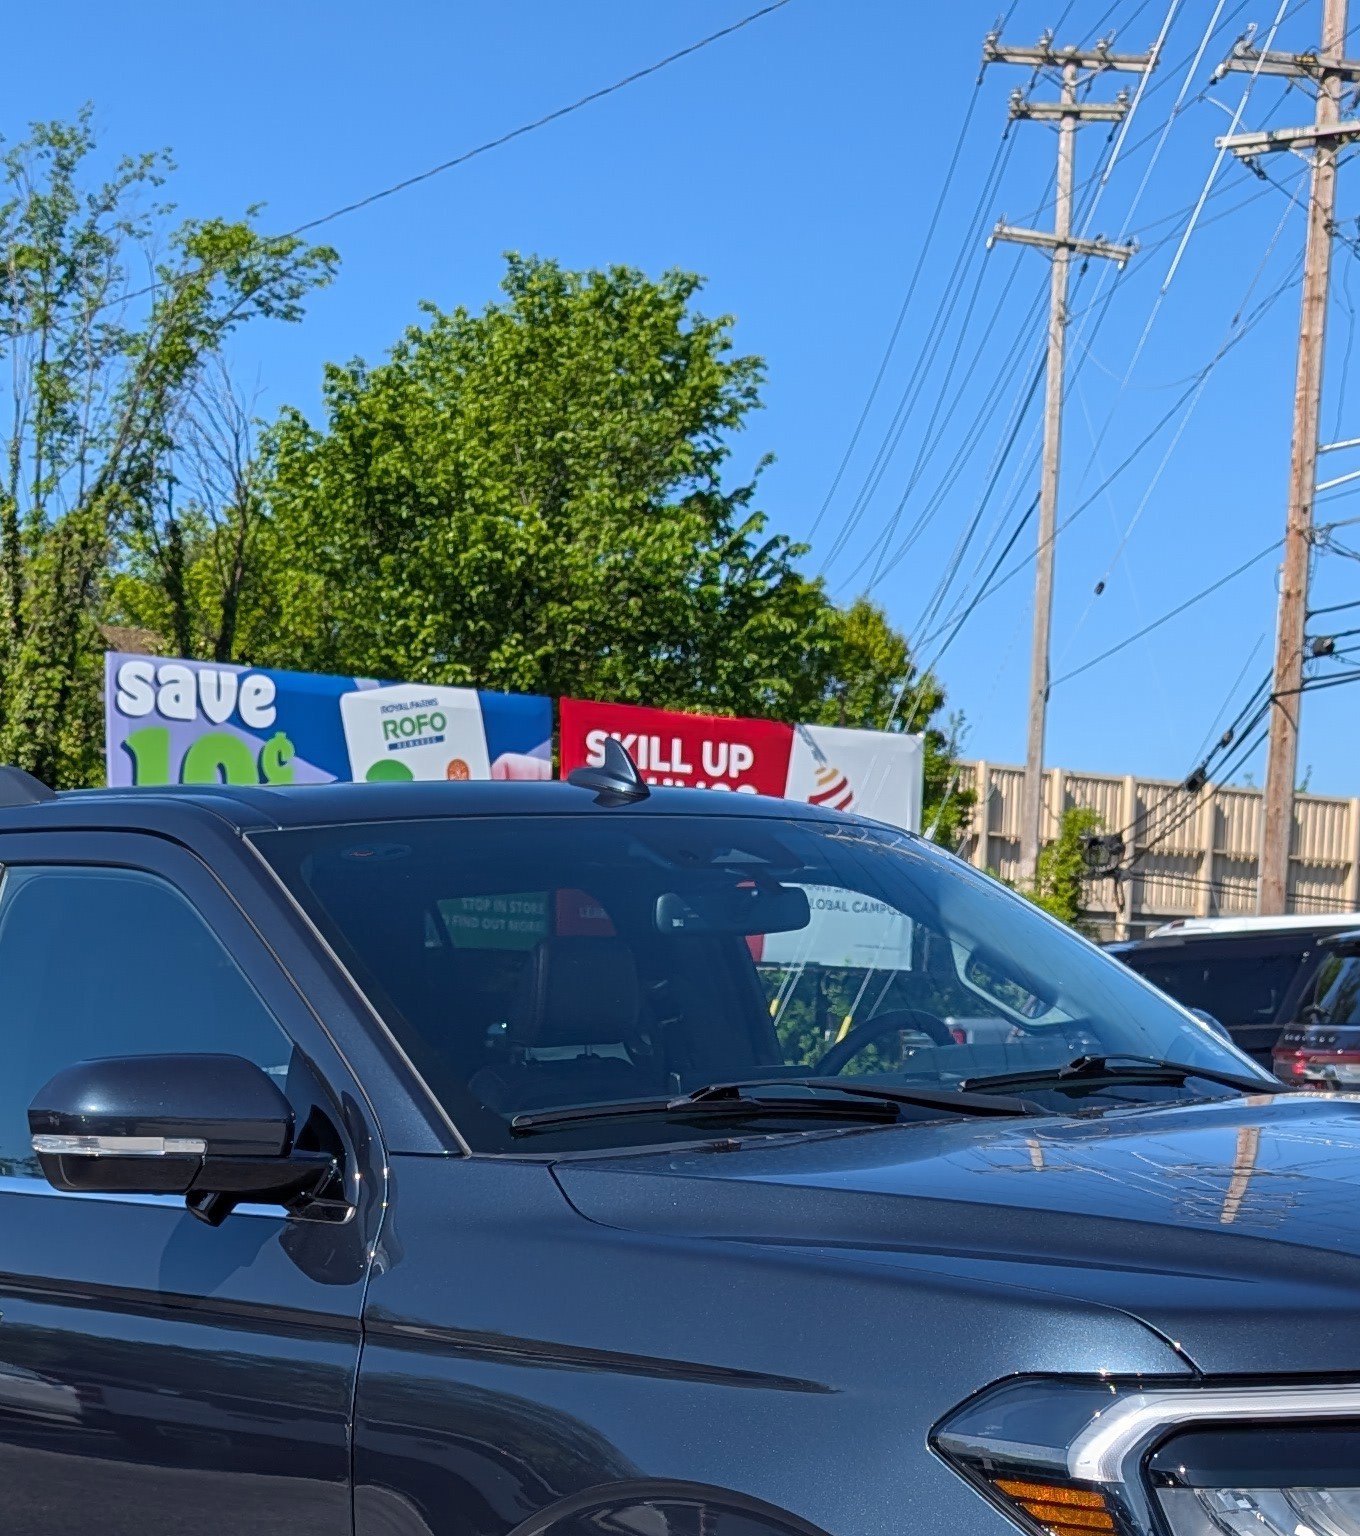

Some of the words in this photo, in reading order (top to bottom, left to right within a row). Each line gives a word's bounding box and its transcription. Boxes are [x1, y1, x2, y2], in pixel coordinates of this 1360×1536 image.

[116, 660, 277, 729] save
[382, 712, 447, 740] ROFO
[702, 740, 754, 778] UP
[809, 898, 849, 912] LOBAL
[852, 901, 900, 917] CAMPU
